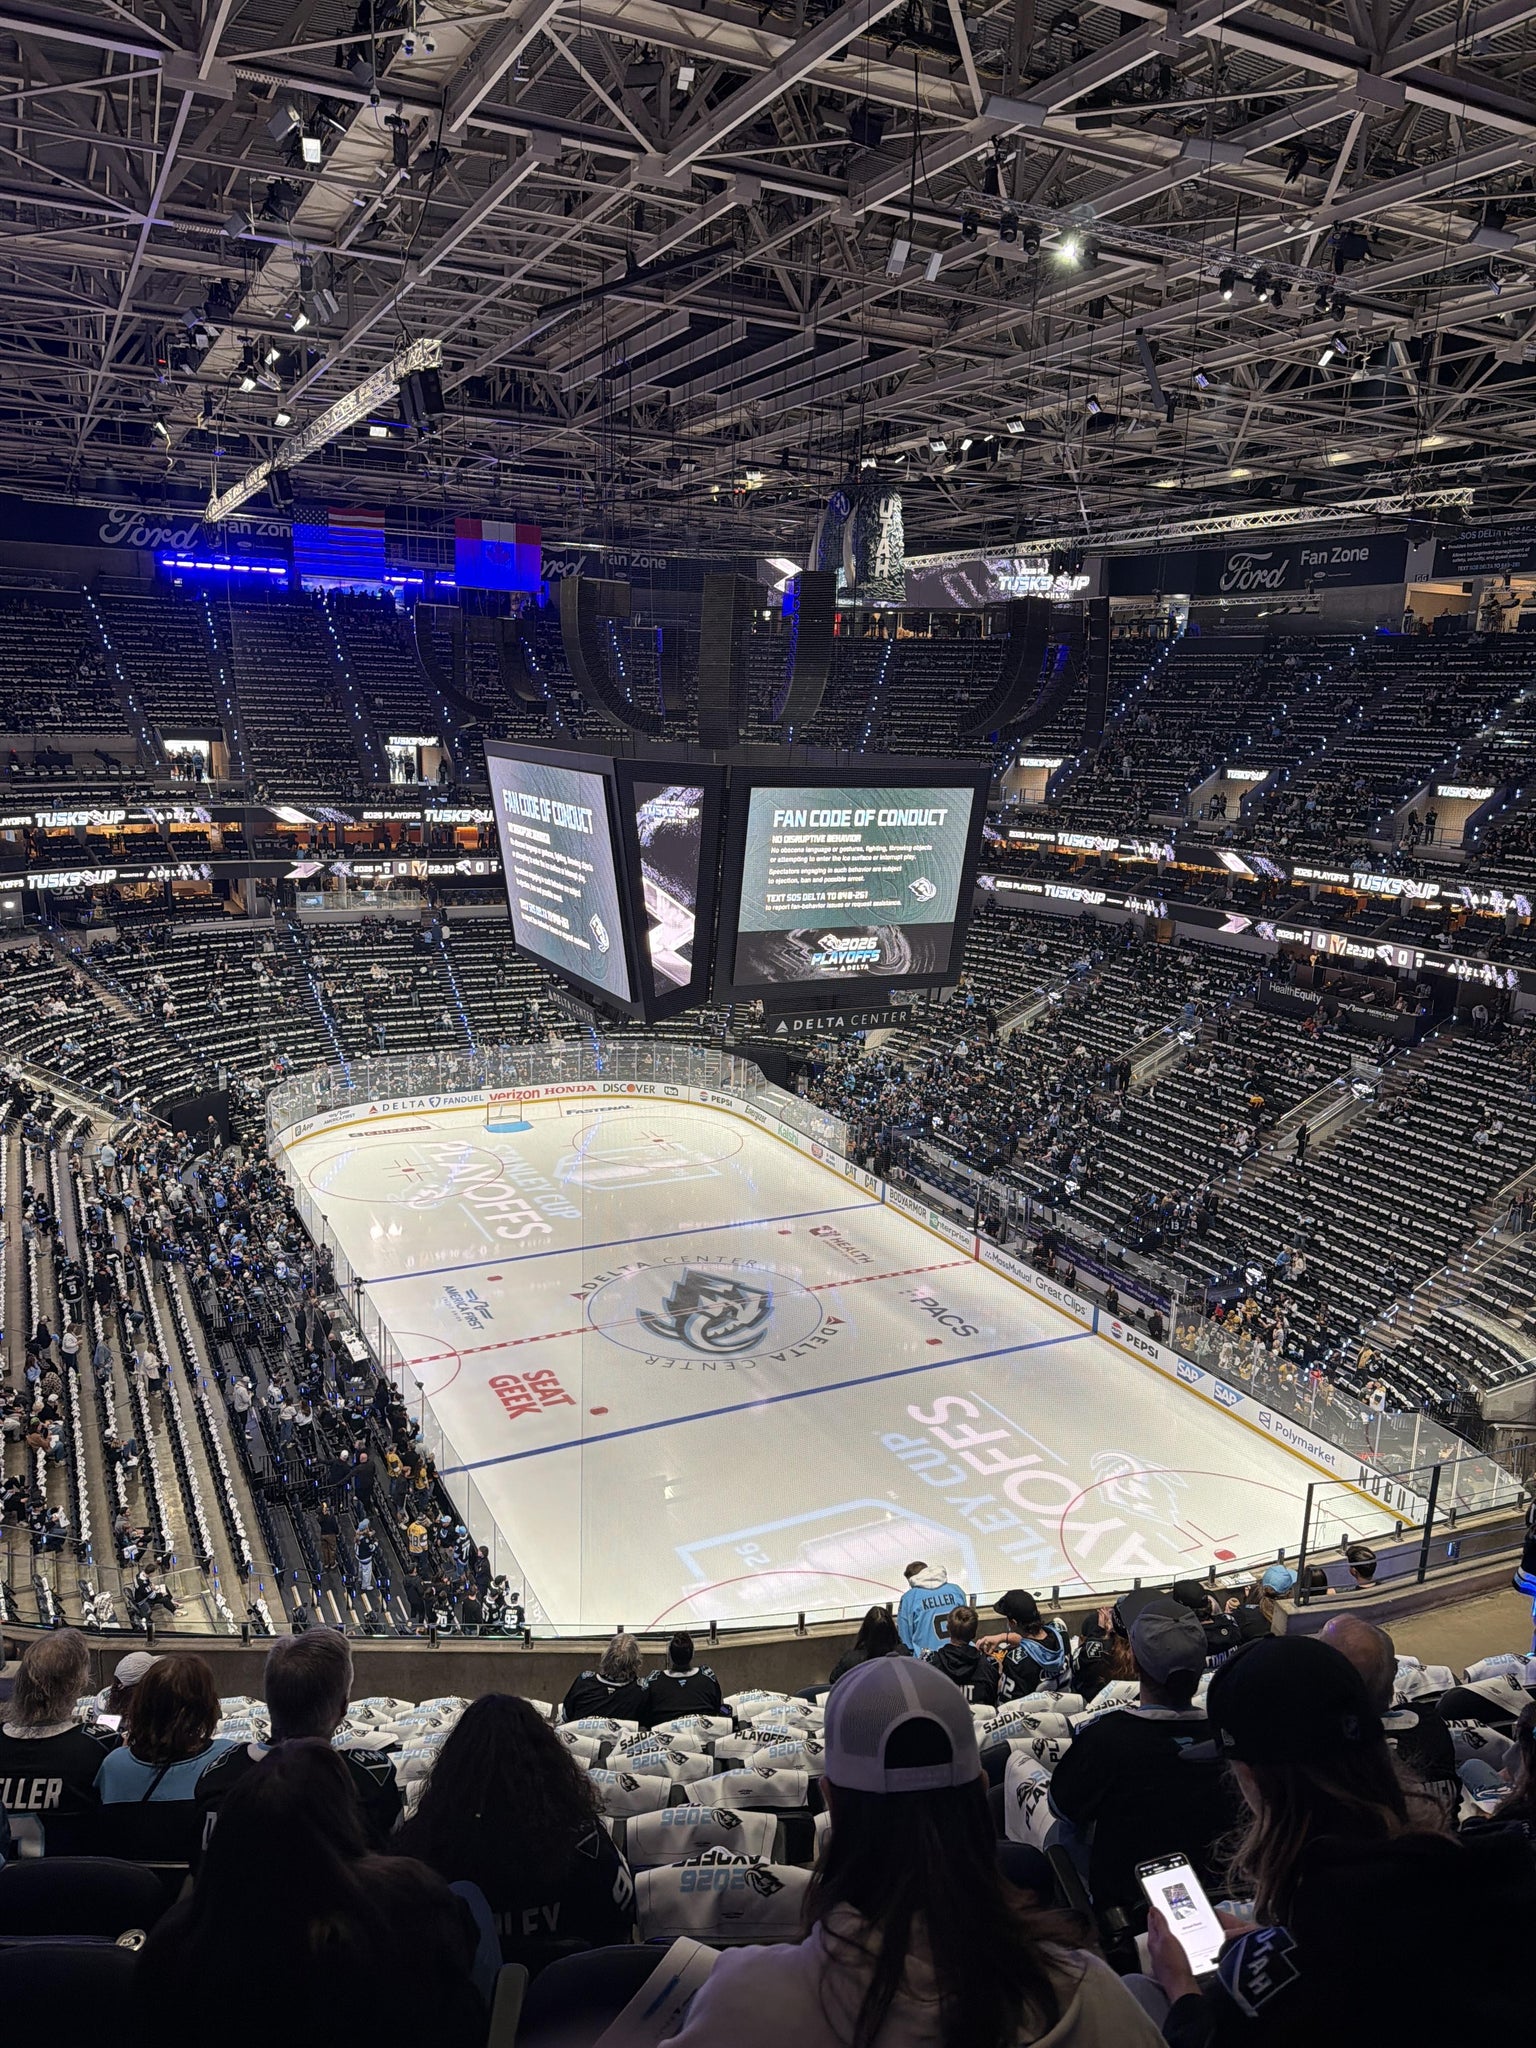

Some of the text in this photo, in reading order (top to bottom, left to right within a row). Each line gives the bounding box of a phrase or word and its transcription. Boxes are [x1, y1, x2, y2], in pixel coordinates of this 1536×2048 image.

[99, 507, 200, 549] Ford
[217, 520, 293, 537] Fan Zon
[875, 498, 893, 579] UTAH
[631, 552, 667, 569] Zone
[1301, 546, 1369, 566] Fan Zone
[1219, 552, 1290, 591] Ford
[1070, 576, 1089, 591] UP
[35, 810, 125, 827] TUSKS UP
[384, 811, 421, 819] PLAYOFFS
[424, 809, 470, 822] TUSKS
[773, 808, 948, 827] FAN CODE OF CONDUCT
[771, 834, 862, 844] NO DISRUPTIVE BEHAVIOR
[1057, 832, 1094, 849] TUSKS
[1104, 838, 1119, 851] UP
[398, 864, 407, 873] 0
[428, 865, 455, 874] 22:30
[27, 869, 117, 890] TUSKS UP
[1293, 867, 1440, 899] 2026 PLAYOFFS TUSKS UP
[766, 894, 786, 902] TEXT
[786, 893, 801, 901] SOS
[802, 892, 826, 901] DELTA
[827, 892, 836, 900] TO
[1044, 884, 1081, 901] TUSKS
[1090, 891, 1105, 904] UP
[841, 937, 878, 949] 2026
[1317, 935, 1326, 947] 0
[1346, 943, 1375, 959] 22:30
[810, 949, 881, 966] PLAYOFFS
[1398, 951, 1408, 965] 0
[1269, 982, 1321, 1005] HealthEquity
[793, 1011, 907, 1031] DELTA CENTER
[488, 1088, 541, 1101] verizon
[544, 1084, 597, 1095] HONDA
[602, 1082, 656, 1094] DISCOVER
[382, 1100, 425, 1112] DELTA
[443, 1094, 484, 1105] FANDUEL
[711, 1094, 733, 1108] PEPSI
[744, 1104, 767, 1124] Energizer
[301, 1122, 314, 1133] App
[777, 1122, 799, 1145] Kalshi
[844, 1162, 857, 1181] CAT
[422, 1139, 553, 1240] PLAYOFFS
[864, 1174, 877, 1193] CAT
[533, 1193, 583, 1219] CUP
[889, 1188, 927, 1218] BODYARMOR
[831, 1237, 875, 1265] HEALTH
[582, 1255, 758, 1291] DELTA CENTER
[991, 1251, 1032, 1284] MassMutual
[69, 1284, 77, 1295] 9
[1035, 1276, 1086, 1316] Great Clips
[442, 1285, 470, 1313] AMERICA
[461, 1308, 485, 1330] FIRST
[911, 1296, 979, 1338] PACS
[644, 1327, 839, 1371] DELTA CENTER
[1126, 1332, 1159, 1360] PEPSI
[1177, 1362, 1199, 1382] SAP
[488, 1374, 543, 1420] GEEK
[522, 1369, 577, 1407] SEAT
[1215, 1384, 1238, 1405] SAP
[1275, 1421, 1336, 1467] Polymarket
[880, 1432, 1072, 1582] NLEY CUP
[921, 1593, 956, 1610] KELLER
[0, 1778, 63, 1809] LLER
[661, 1807, 713, 1827] 2026
[680, 1868, 746, 1893] 2026
[1248, 1929, 1276, 1995] UTAH
